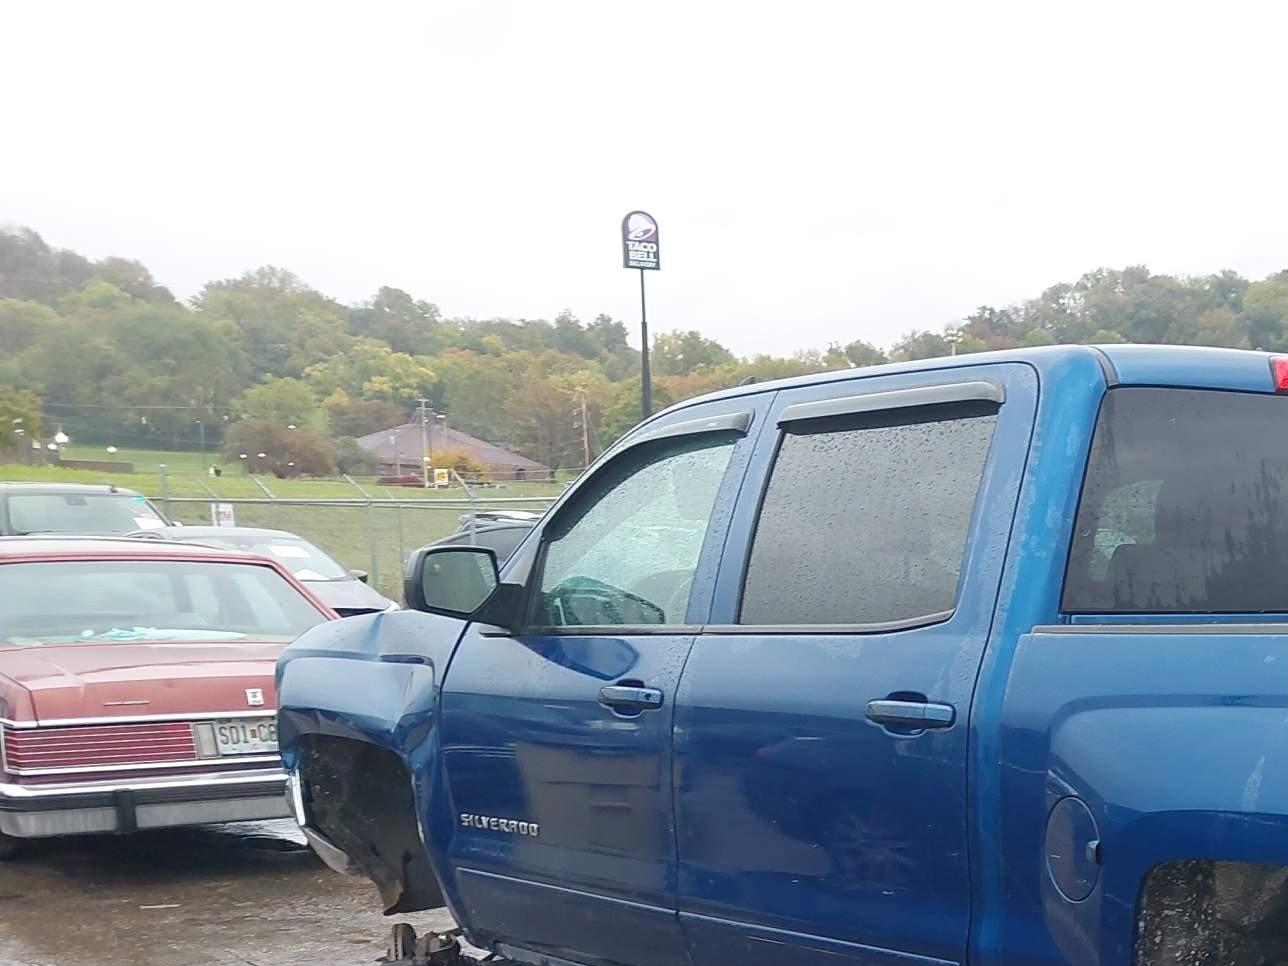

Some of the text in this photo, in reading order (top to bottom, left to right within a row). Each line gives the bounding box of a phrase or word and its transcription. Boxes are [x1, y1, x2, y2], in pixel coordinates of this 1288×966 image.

[626, 241, 657, 252] TACO
[629, 251, 657, 261] BELL
[460, 813, 540, 837] SILVERADO
